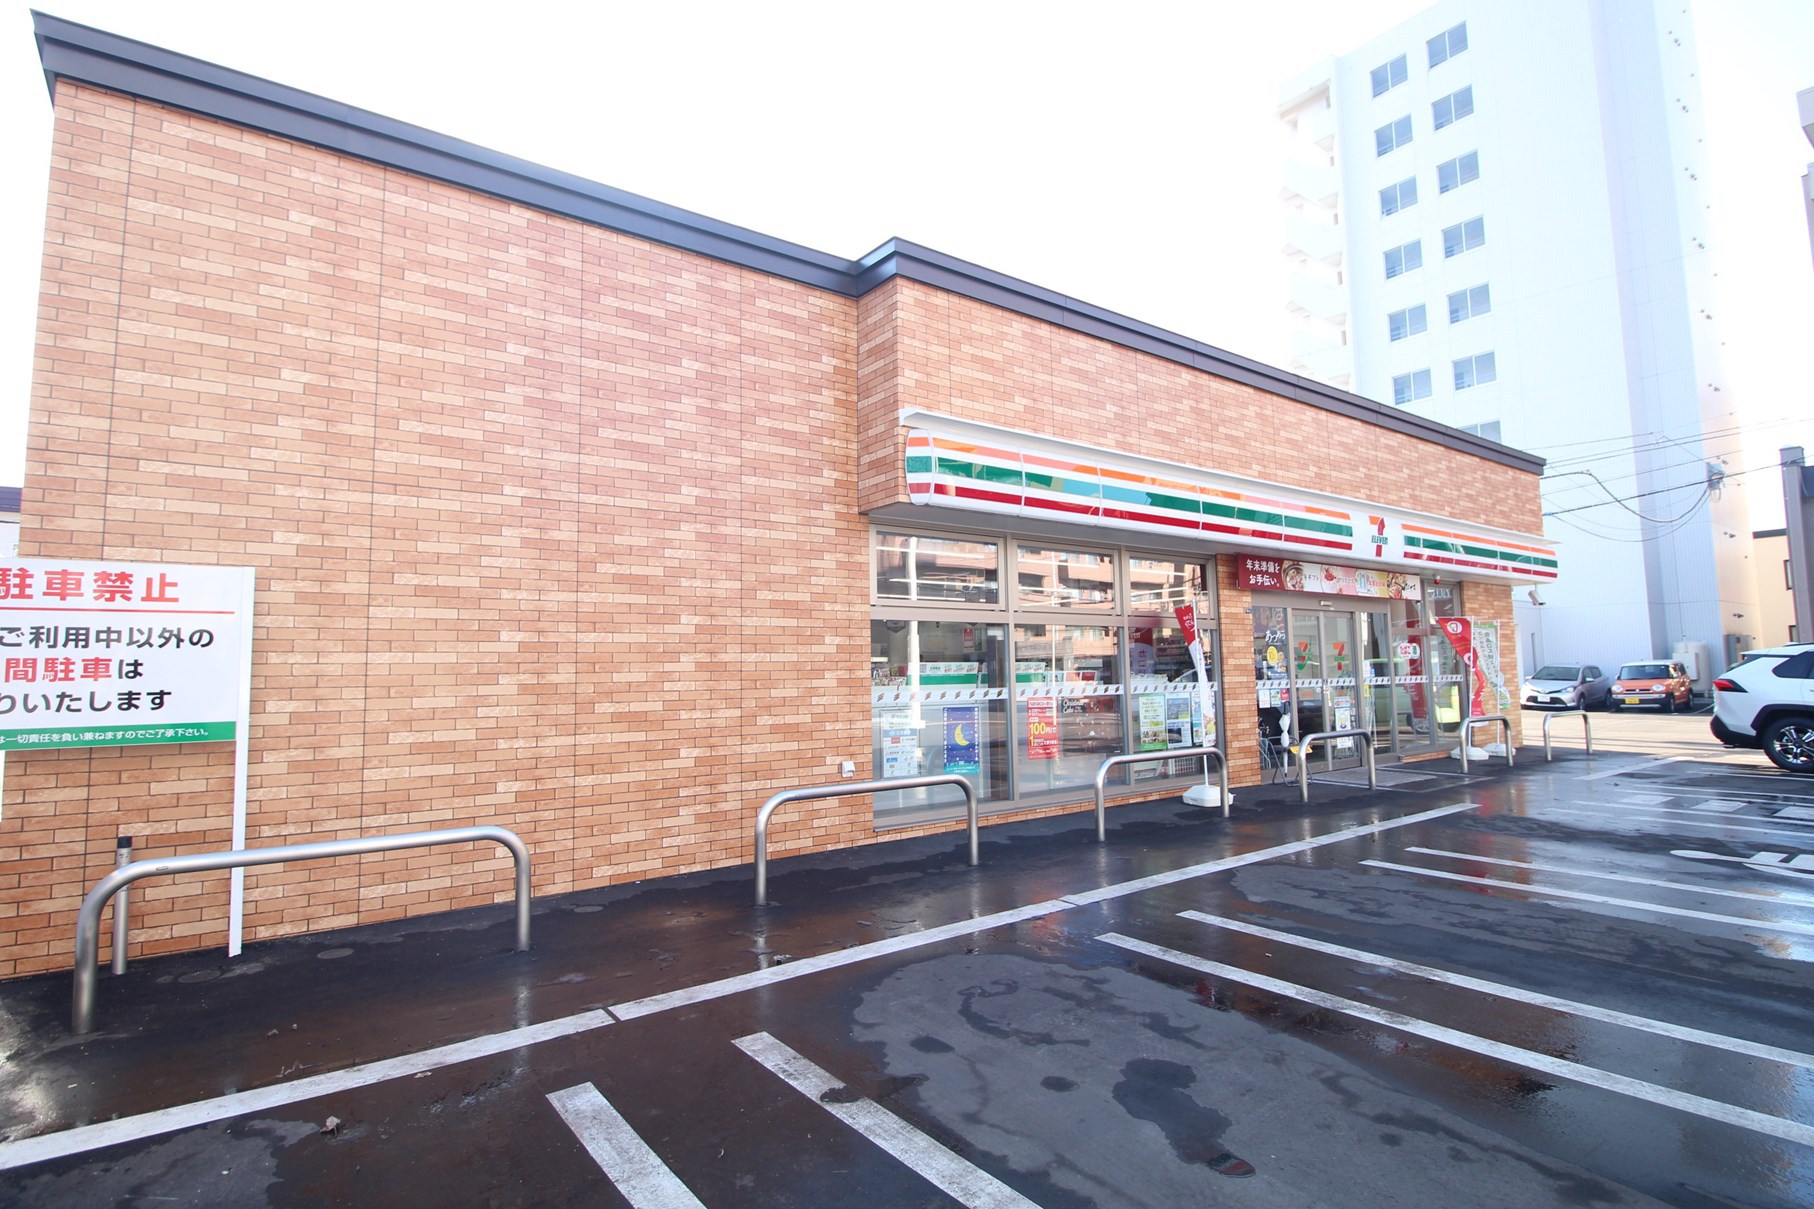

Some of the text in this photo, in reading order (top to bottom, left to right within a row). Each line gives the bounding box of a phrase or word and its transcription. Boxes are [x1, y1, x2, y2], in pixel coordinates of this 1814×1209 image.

[1246, 559, 1280, 574] 年末準備を
[0, 567, 180, 603] 駐車禁止
[0, 626, 214, 649] ご利用中以外の
[4, 656, 144, 683] 間駐車は
